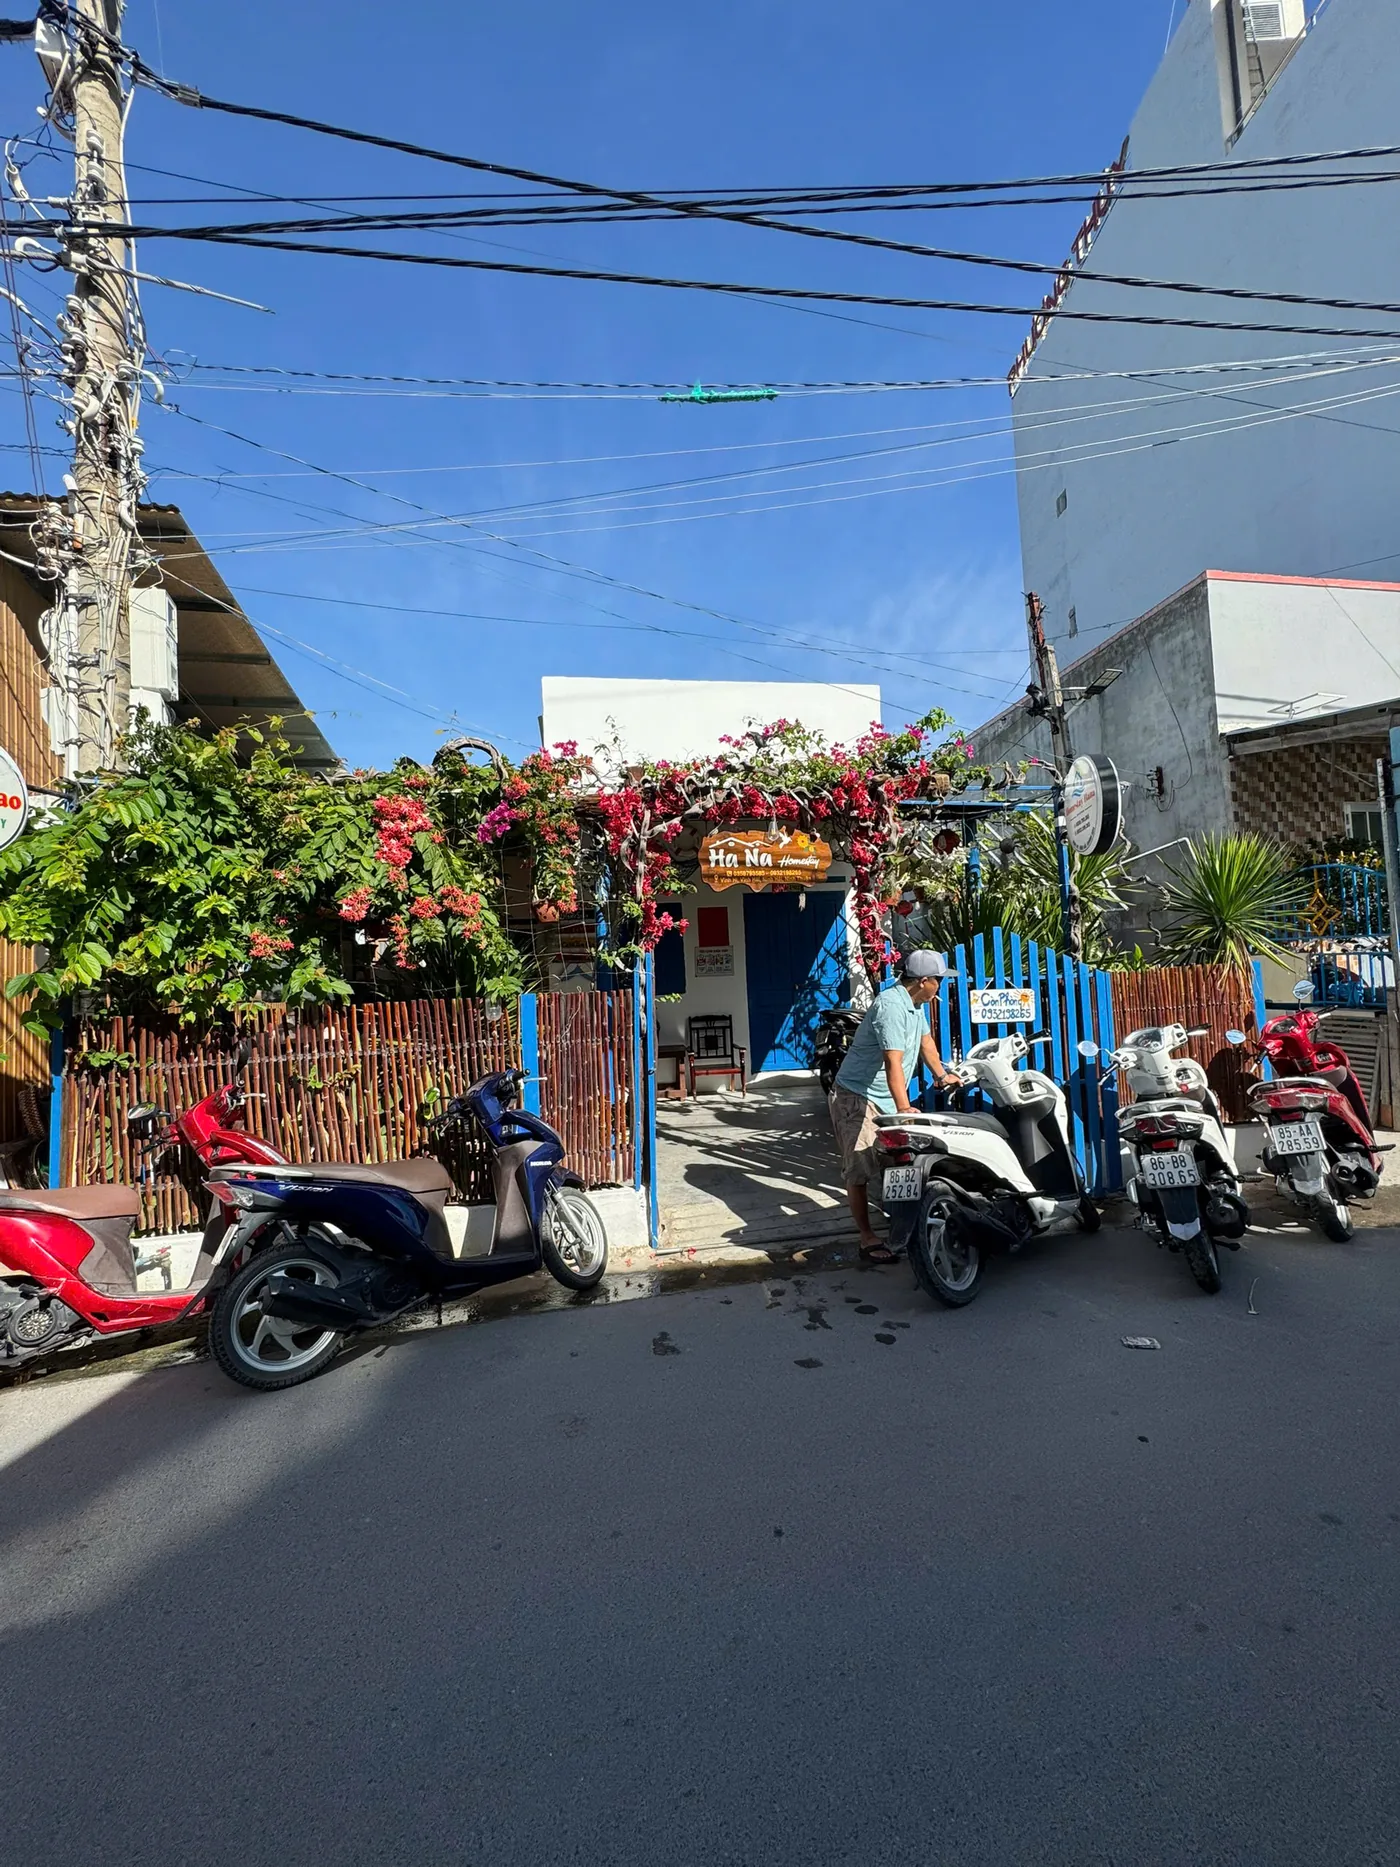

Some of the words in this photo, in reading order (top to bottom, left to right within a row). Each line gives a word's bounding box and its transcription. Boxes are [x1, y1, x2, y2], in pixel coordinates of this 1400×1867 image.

[708, 848, 739, 868] Ha
[745, 848, 773, 867] Na
[777, 854, 820, 869] Homestay
[981, 1008, 1032, 1020] 0932198265
[1278, 1124, 1313, 1139] 85-AA
[1278, 1136, 1321, 1152] 285.59
[1150, 1155, 1187, 1171] 86-B8
[1149, 1169, 1197, 1187] 308.65
[885, 1183, 918, 1199] 252.84
